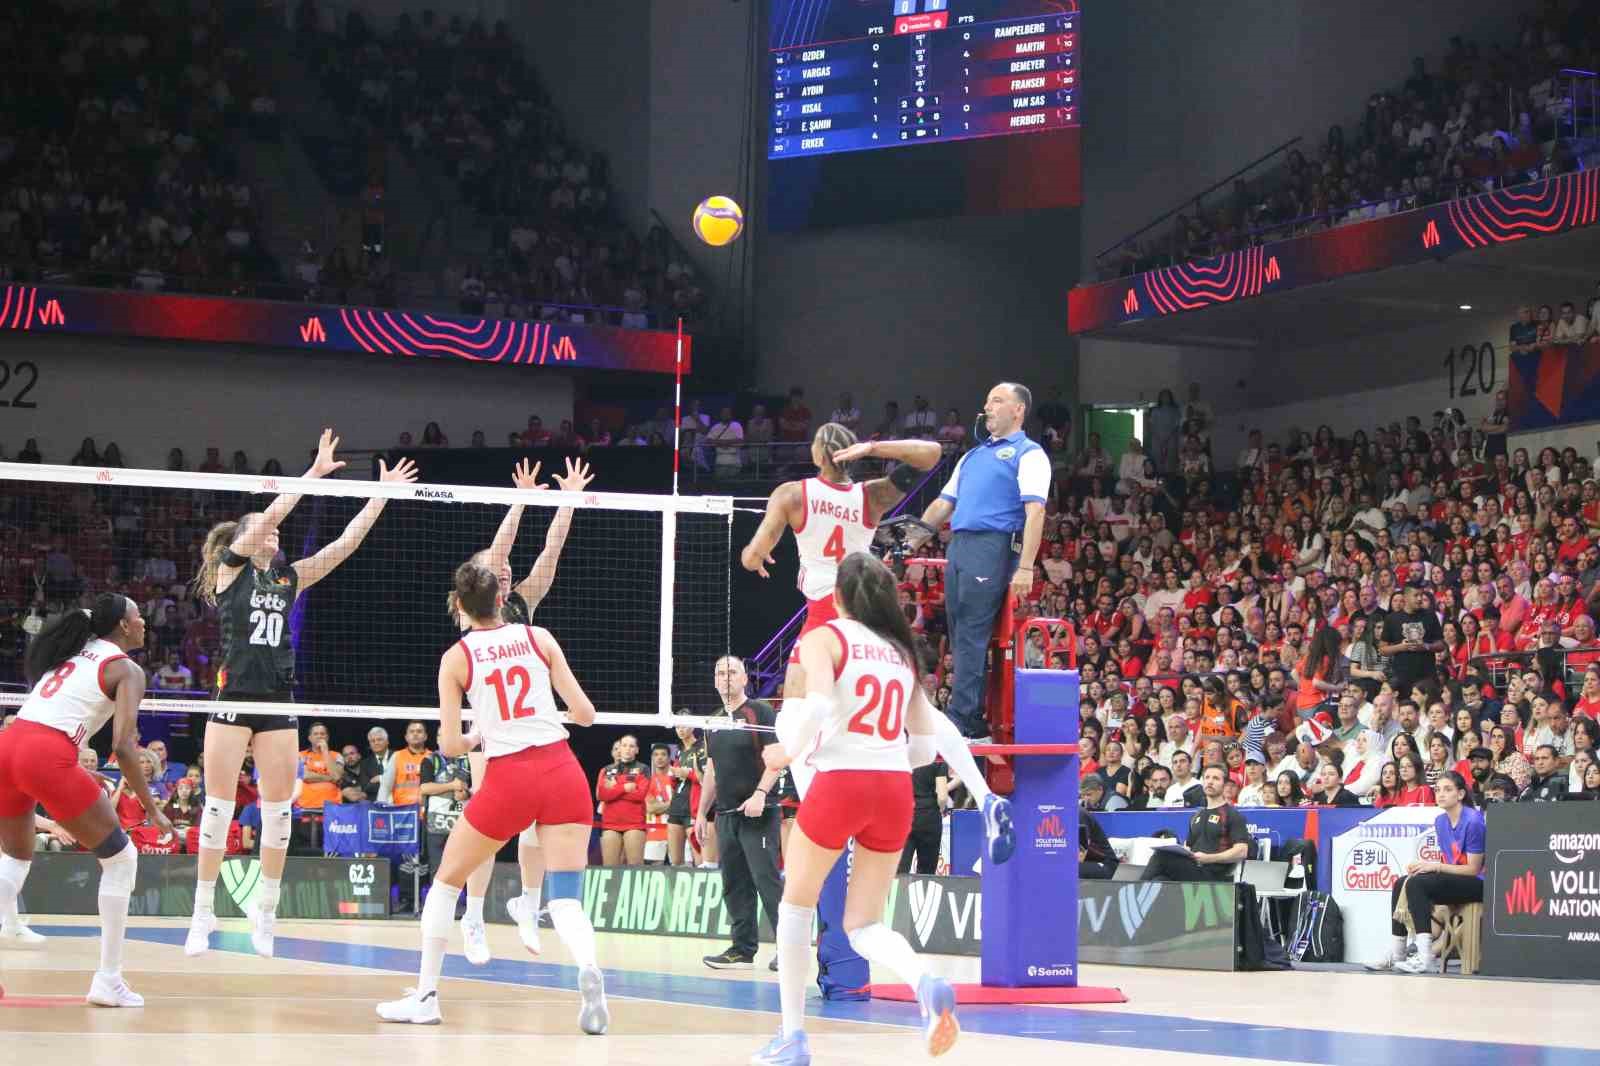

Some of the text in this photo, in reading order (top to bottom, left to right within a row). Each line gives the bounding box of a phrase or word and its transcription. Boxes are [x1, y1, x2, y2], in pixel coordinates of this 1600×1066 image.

[958, 15, 975, 23] PTS
[868, 26, 884, 35] PTS
[994, 22, 1045, 38] RAMPELBERG
[1015, 41, 1045, 54] MARTIN
[802, 66, 831, 79] VARGAS
[1010, 59, 1045, 72] DEMEYER
[801, 85, 824, 96] AYDIN
[1011, 76, 1045, 91] FRANSEN
[1013, 95, 1045, 108] VAN SAS
[1010, 113, 1045, 127] HERBOTS
[1443, 341, 1495, 399] 120
[811, 499, 860, 523] VARGAS
[823, 524, 847, 564] 4
[249, 609, 284, 648] 20
[473, 639, 531, 663] E.ŞAHİN
[40, 661, 76, 699] 8
[484, 665, 535, 721] 12
[847, 673, 904, 742] 20
[1549, 833, 1600, 851] amazon
[1353, 848, 1388, 866] 百岁山
[349, 863, 376, 884] 62.3
[612, 869, 666, 931] AND
[1037, 967, 1073, 977] Senoh
